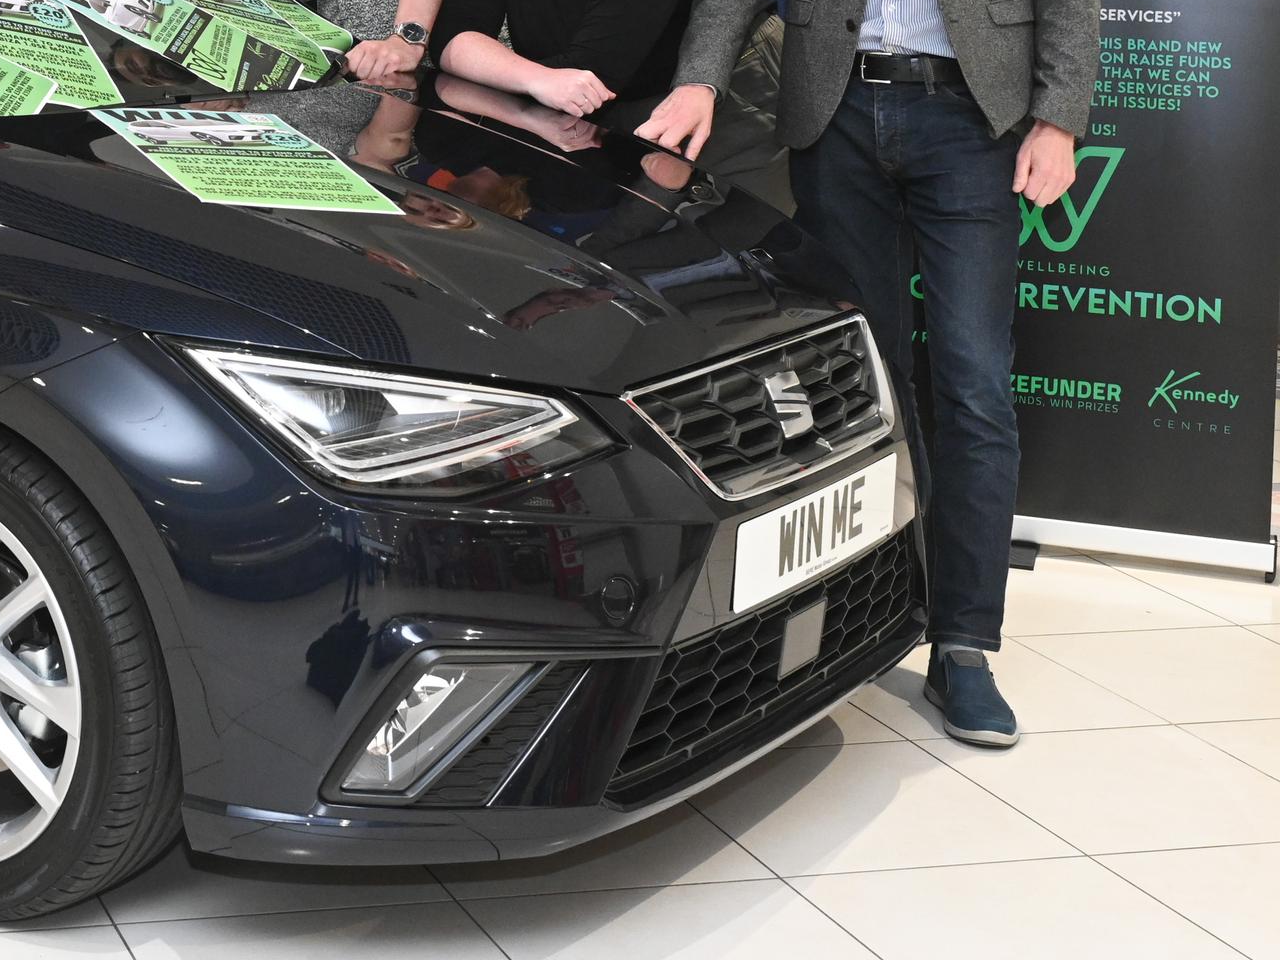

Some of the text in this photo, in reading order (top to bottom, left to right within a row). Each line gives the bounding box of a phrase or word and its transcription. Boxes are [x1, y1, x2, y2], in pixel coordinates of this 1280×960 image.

[31, 6, 64, 19] £20
[1098, 37, 1222, 54] HIS BRAND NEW
[1129, 54, 1174, 67] RAISE
[1179, 56, 1232, 69] FUNDS
[1103, 67, 1210, 83] THAT WE CAN
[1117, 82, 1192, 97] SERVICES
[1197, 85, 1219, 98] TO
[1124, 96, 1181, 111] ISSUES!
[103, 109, 241, 124] WIN
[1016, 282, 1221, 325] REVENTION
[1147, 369, 1240, 413] Kennedy
[1050, 399, 1073, 409] WIN
[1078, 401, 1119, 413] PRIZES
[1153, 418, 1231, 435] CENTRE
[778, 475, 866, 577] WIN ME
